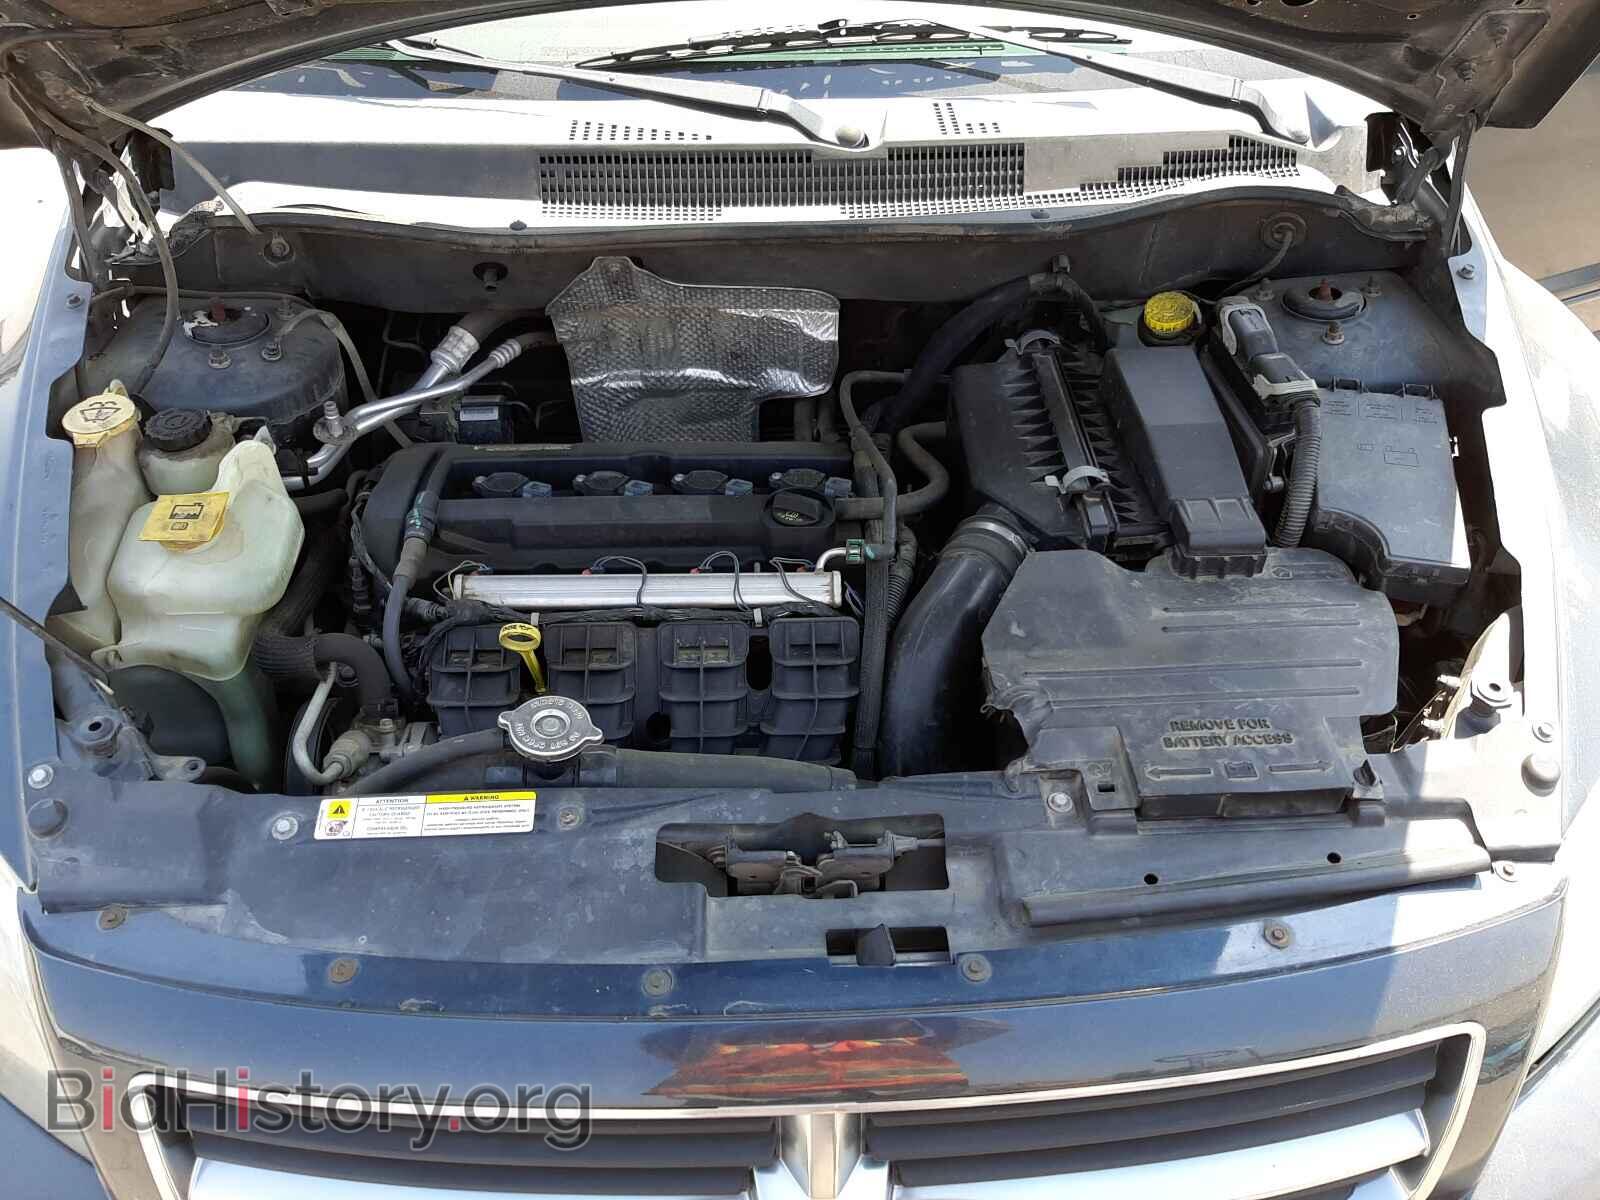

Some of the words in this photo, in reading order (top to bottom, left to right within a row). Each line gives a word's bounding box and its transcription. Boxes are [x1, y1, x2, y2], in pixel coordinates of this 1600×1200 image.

[1169, 719, 1235, 732] REMOVE
[1239, 717, 1270, 730] FOR
[1162, 735, 1228, 749] BATTERY
[1232, 733, 1294, 746] ACCESS
